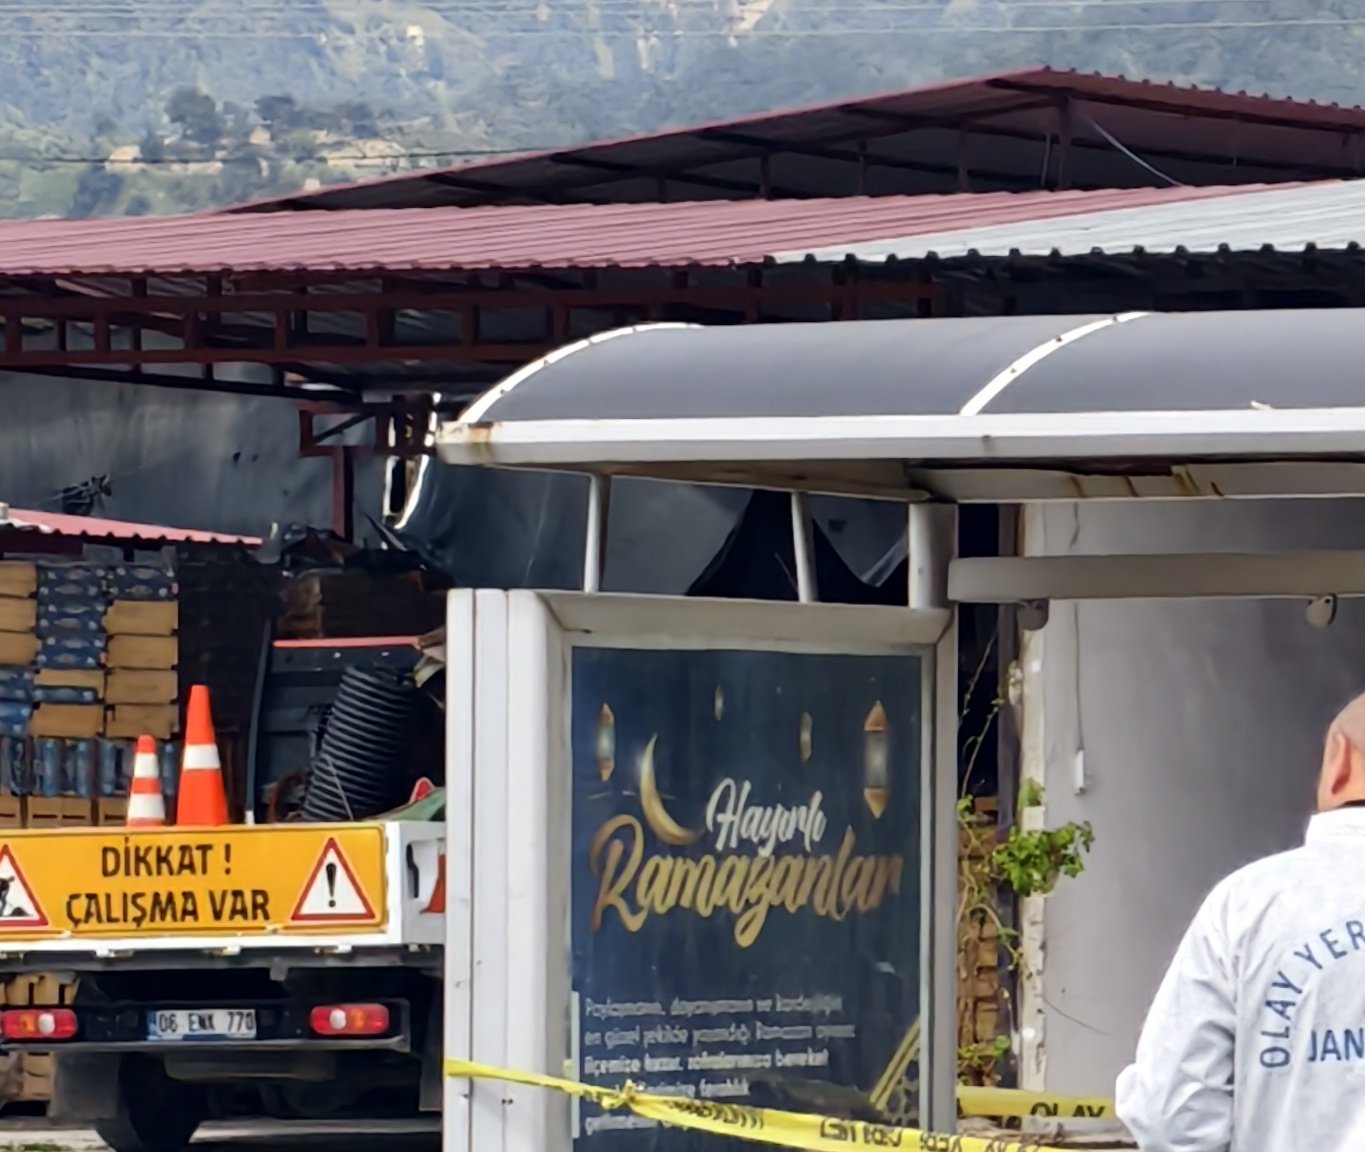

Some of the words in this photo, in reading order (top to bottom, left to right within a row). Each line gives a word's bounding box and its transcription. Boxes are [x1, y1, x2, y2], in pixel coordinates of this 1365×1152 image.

[101, 836, 214, 877] DİKKAT
[706, 777, 828, 857] Hayırlı
[66, 890, 199, 928] ÇALIŞMA
[209, 890, 270, 922] VAR
[590, 814, 904, 948] Ramazanlar
[1259, 968, 1306, 1070] OLAY
